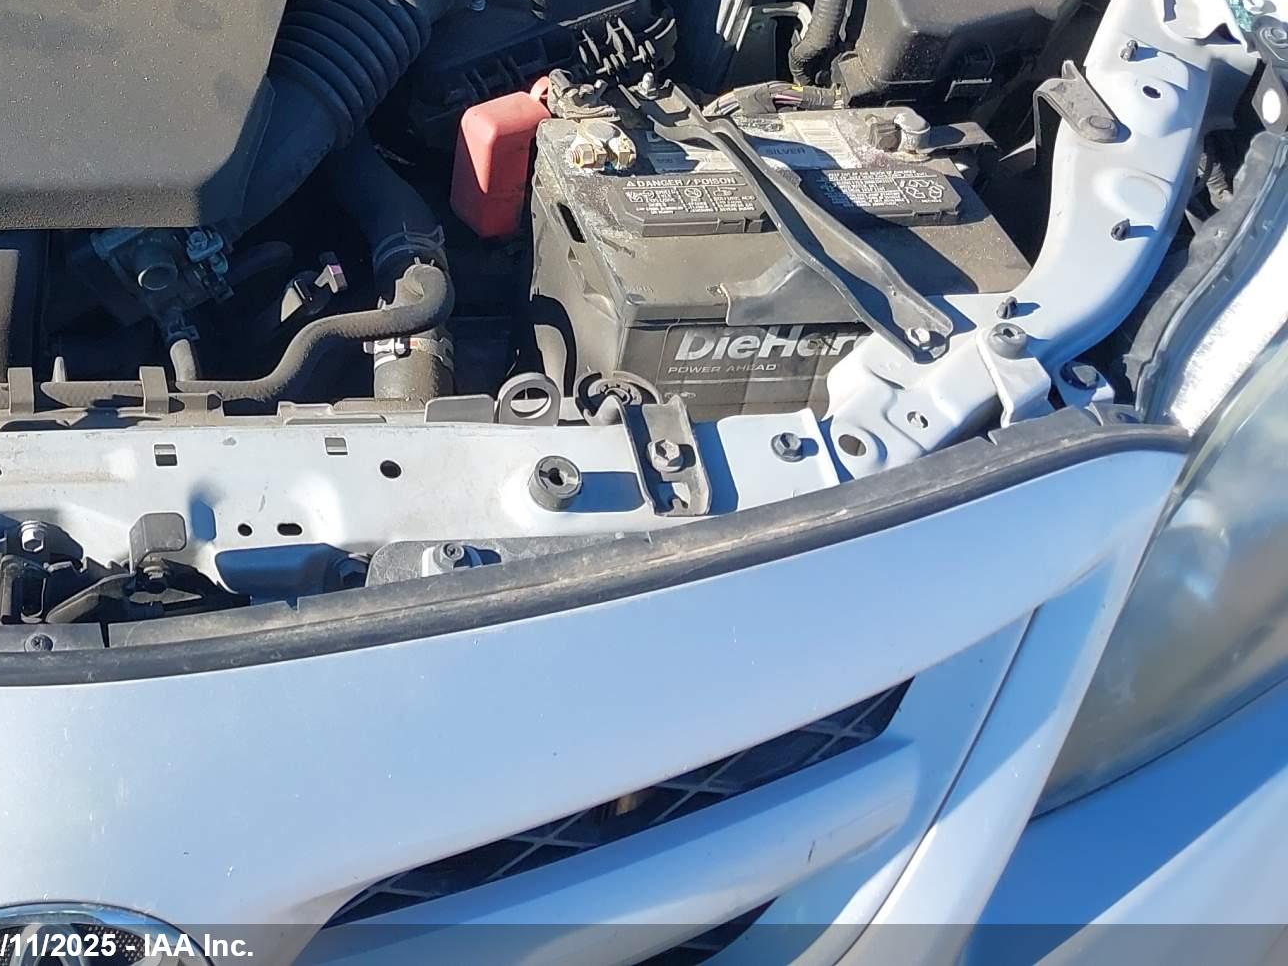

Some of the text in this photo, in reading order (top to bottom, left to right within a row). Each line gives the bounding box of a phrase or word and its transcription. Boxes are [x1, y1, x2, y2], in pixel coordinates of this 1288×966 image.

[636, 178, 683, 187] DANGER
[693, 176, 736, 185] POISON
[674, 325, 870, 361] DieHar
[668, 363, 777, 374] POWER AHEAD
